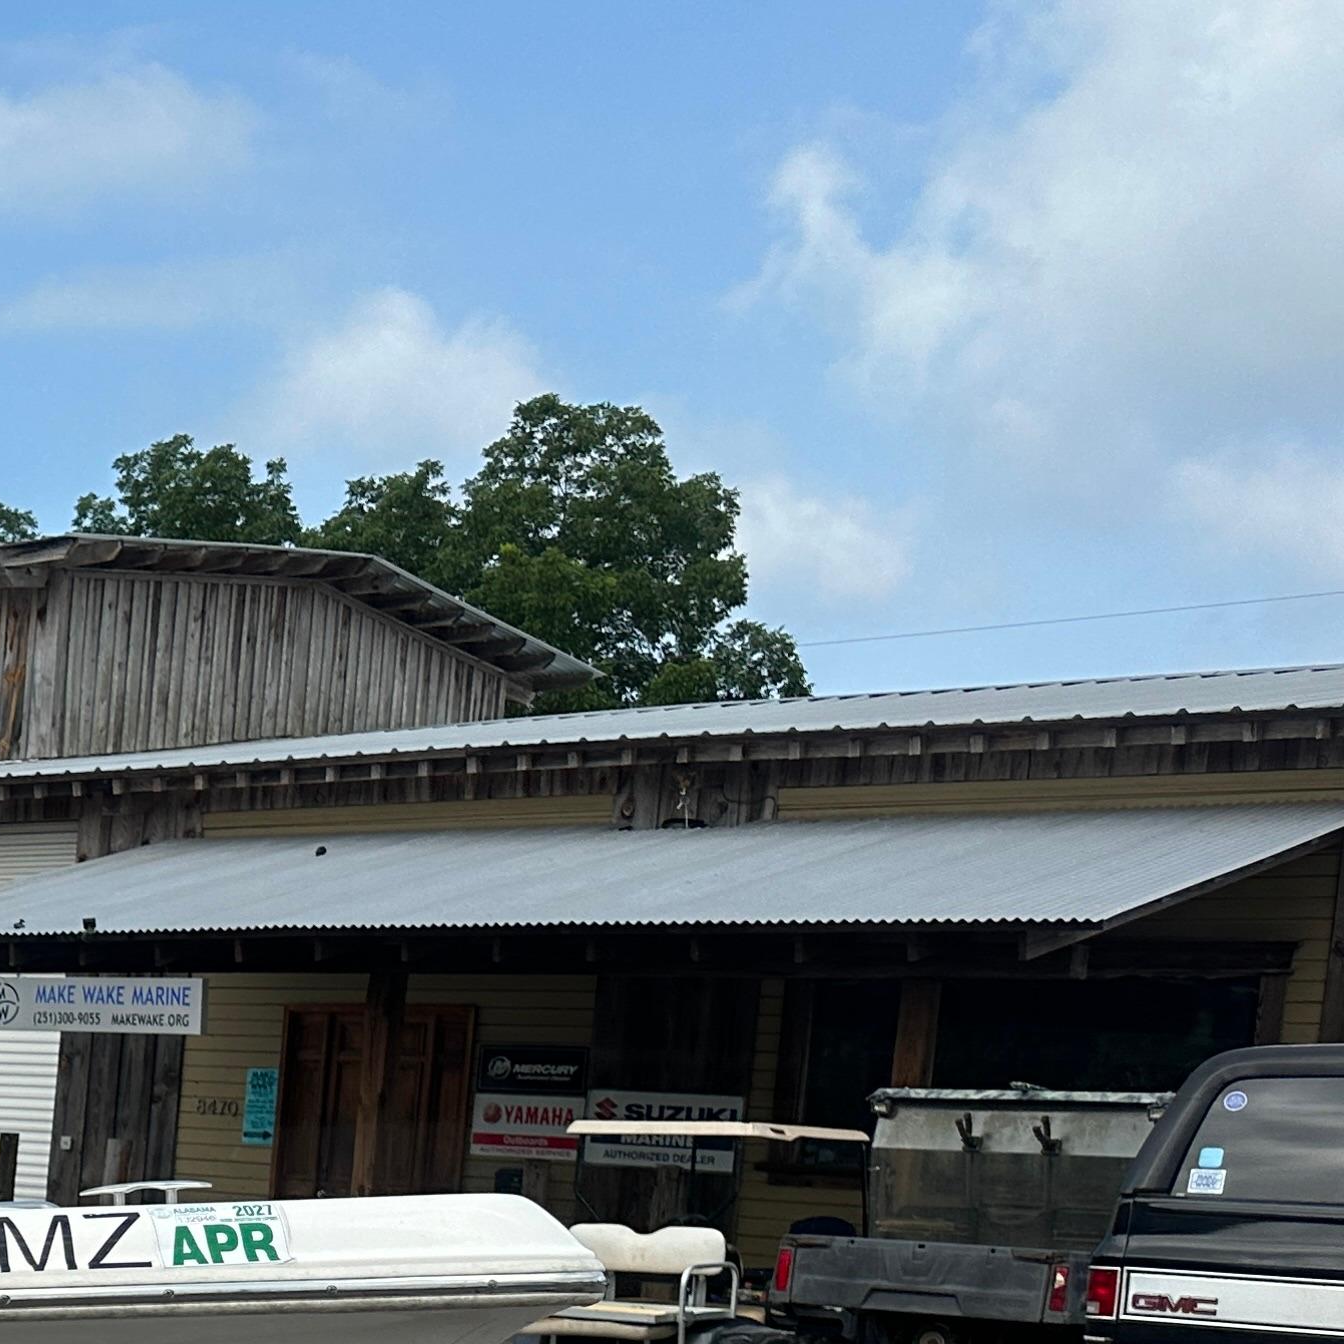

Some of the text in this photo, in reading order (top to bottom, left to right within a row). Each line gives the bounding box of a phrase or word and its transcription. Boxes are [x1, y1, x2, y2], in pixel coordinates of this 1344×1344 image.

[35, 985, 191, 1006] MAKE WAKE MARINE
[33, 1011, 101, 1025] (251)300-9055
[513, 1064, 579, 1075] MERCURY
[504, 1103, 575, 1126] YAMAHA
[624, 1103, 738, 1121] SUZUKI
[502, 1135, 549, 1147] Outboards
[602, 1149, 716, 1166] AUTHORIZED DEALER
[173, 1204, 273, 1217] ALABAMA 2027
[173, 1222, 281, 1266] APR
[1132, 1292, 1219, 1316] GMC
